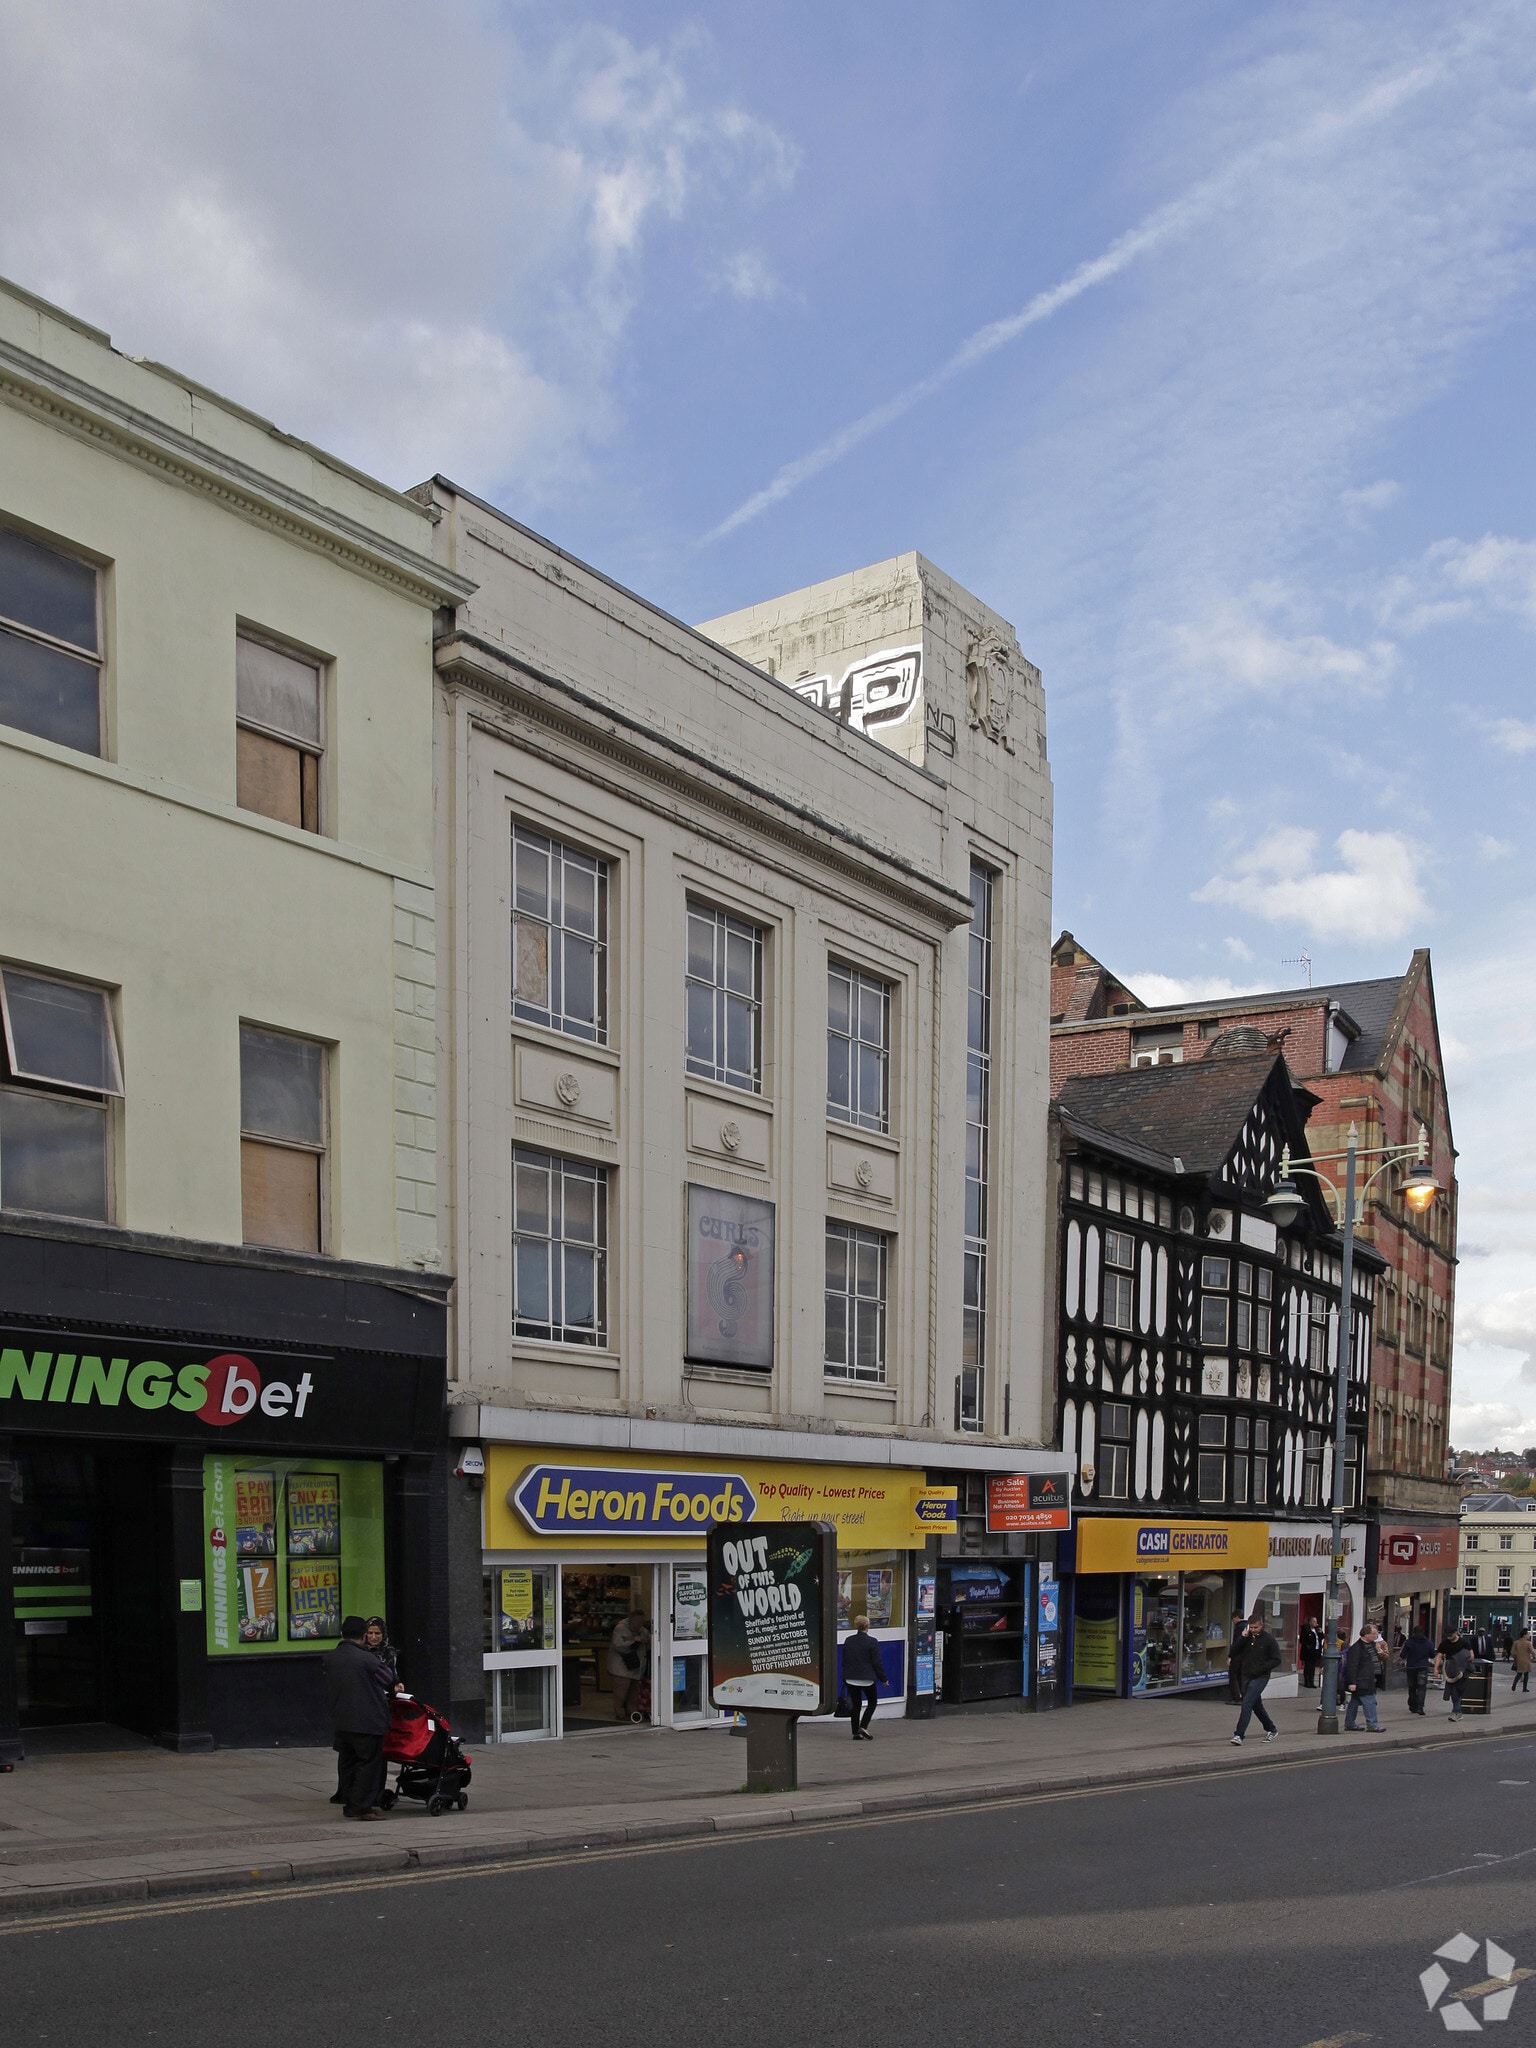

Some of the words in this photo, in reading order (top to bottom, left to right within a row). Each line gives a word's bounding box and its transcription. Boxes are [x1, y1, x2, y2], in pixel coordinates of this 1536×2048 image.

[248, 1480, 270, 1494] PAY
[759, 1483, 776, 1499] Top
[779, 1483, 814, 1500] Quality
[823, 1485, 856, 1498] Lowest
[857, 1487, 885, 1499] Prices
[535, 1477, 646, 1521] Heron
[651, 1482, 744, 1522] Foods
[1033, 1494, 1064, 1502] acuitus
[292, 1504, 337, 1526] HERE
[922, 1510, 947, 1518] Foods
[1139, 1533, 1168, 1550] CASH
[1172, 1533, 1228, 1550] GENERATOR
[1313, 1534, 1350, 1556] ARCDE
[723, 1536, 769, 1576] OUT
[1334, 1556, 1343, 1567] H
[254, 1567, 269, 1588] 7
[291, 1574, 319, 1590] ONLY
[738, 1574, 750, 1590] OF
[751, 1570, 776, 1587] THIS
[294, 1587, 340, 1611] HERE
[736, 1583, 802, 1618] WORLD
[745, 1616, 775, 1628] Sheffield's
[776, 1612, 797, 1623] festival
[798, 1611, 804, 1619] of
[748, 1634, 772, 1645] SUNDAY
[772, 1633, 780, 1641] 25
[781, 1629, 808, 1640] OCTOBER
[762, 1624, 778, 1633] magic
[752, 1657, 812, 1672] OUTOFTHISWORLD
